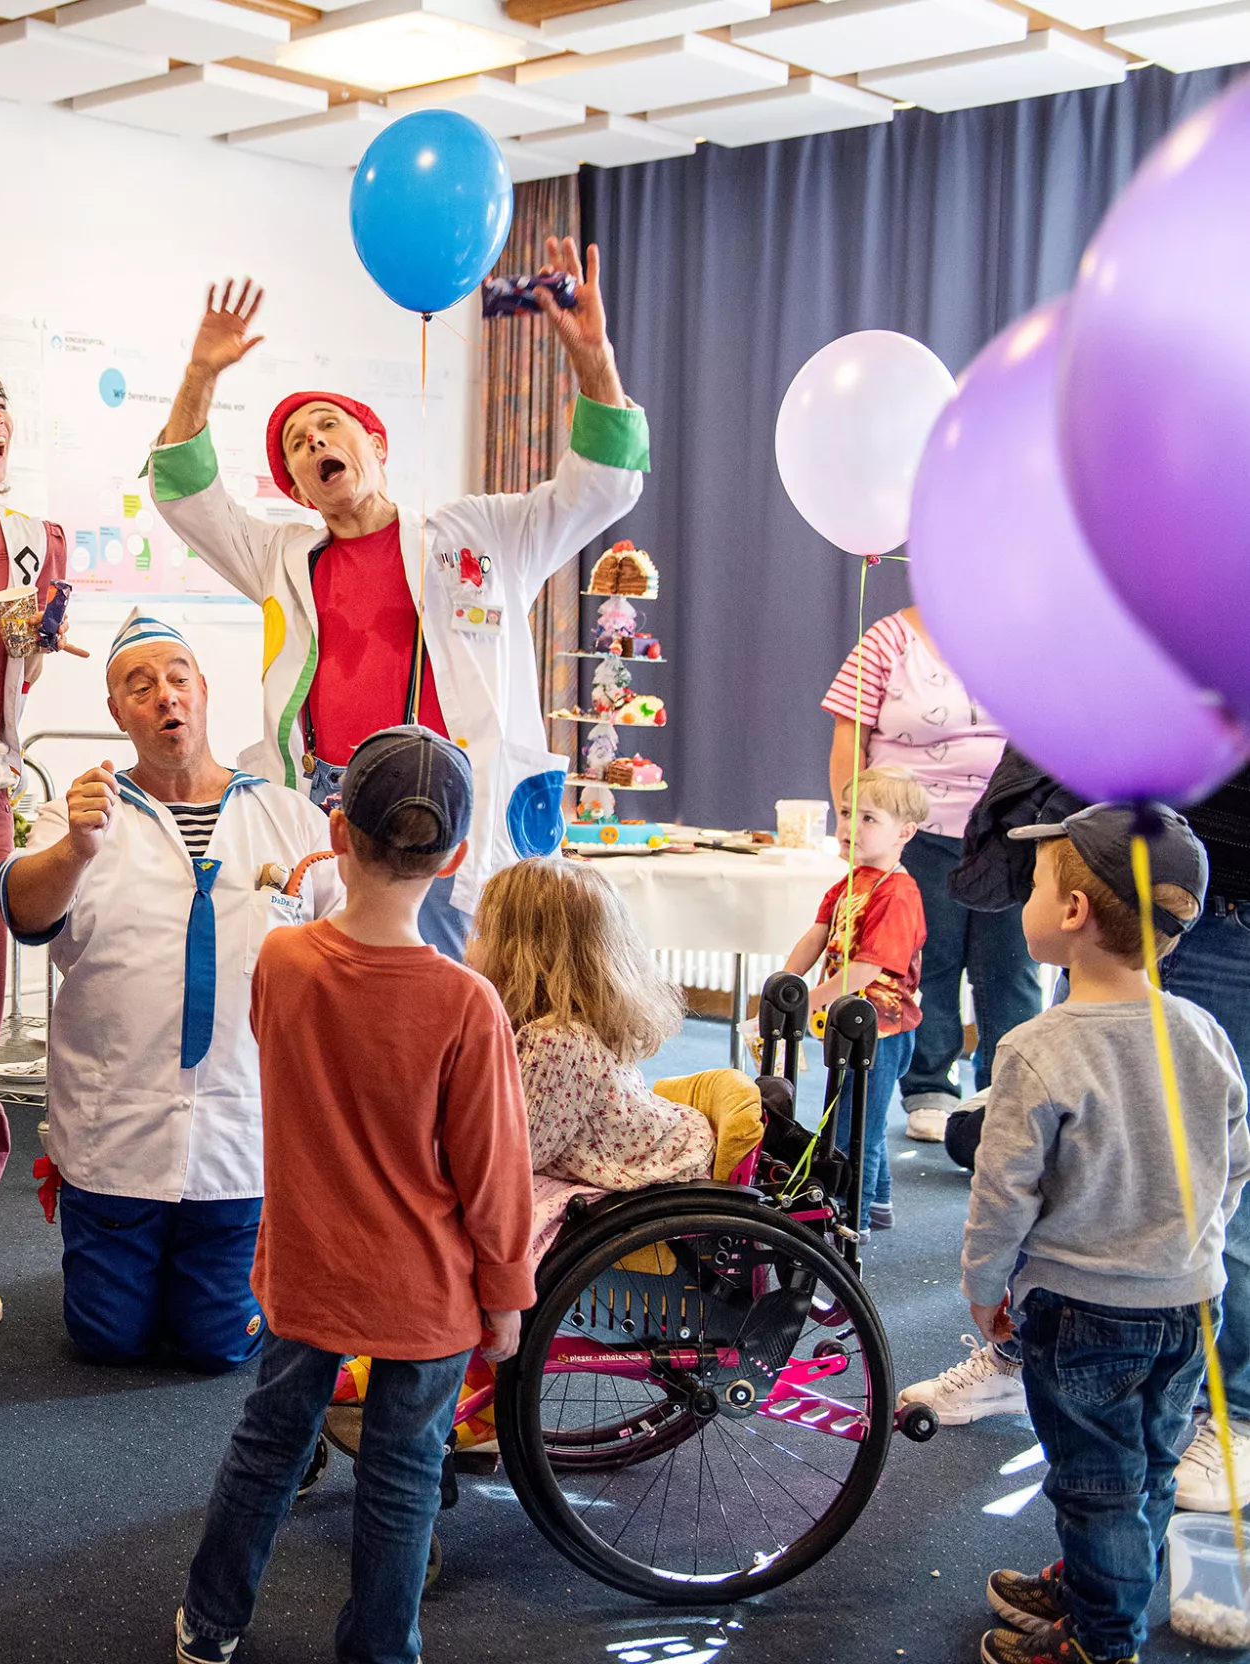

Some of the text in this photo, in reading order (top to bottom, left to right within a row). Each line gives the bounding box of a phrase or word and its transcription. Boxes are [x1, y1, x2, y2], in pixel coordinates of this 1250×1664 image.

[113, 388, 126, 399] Wir
[128, 391, 157, 402] bereiten
[234, 403, 245, 411] vor
